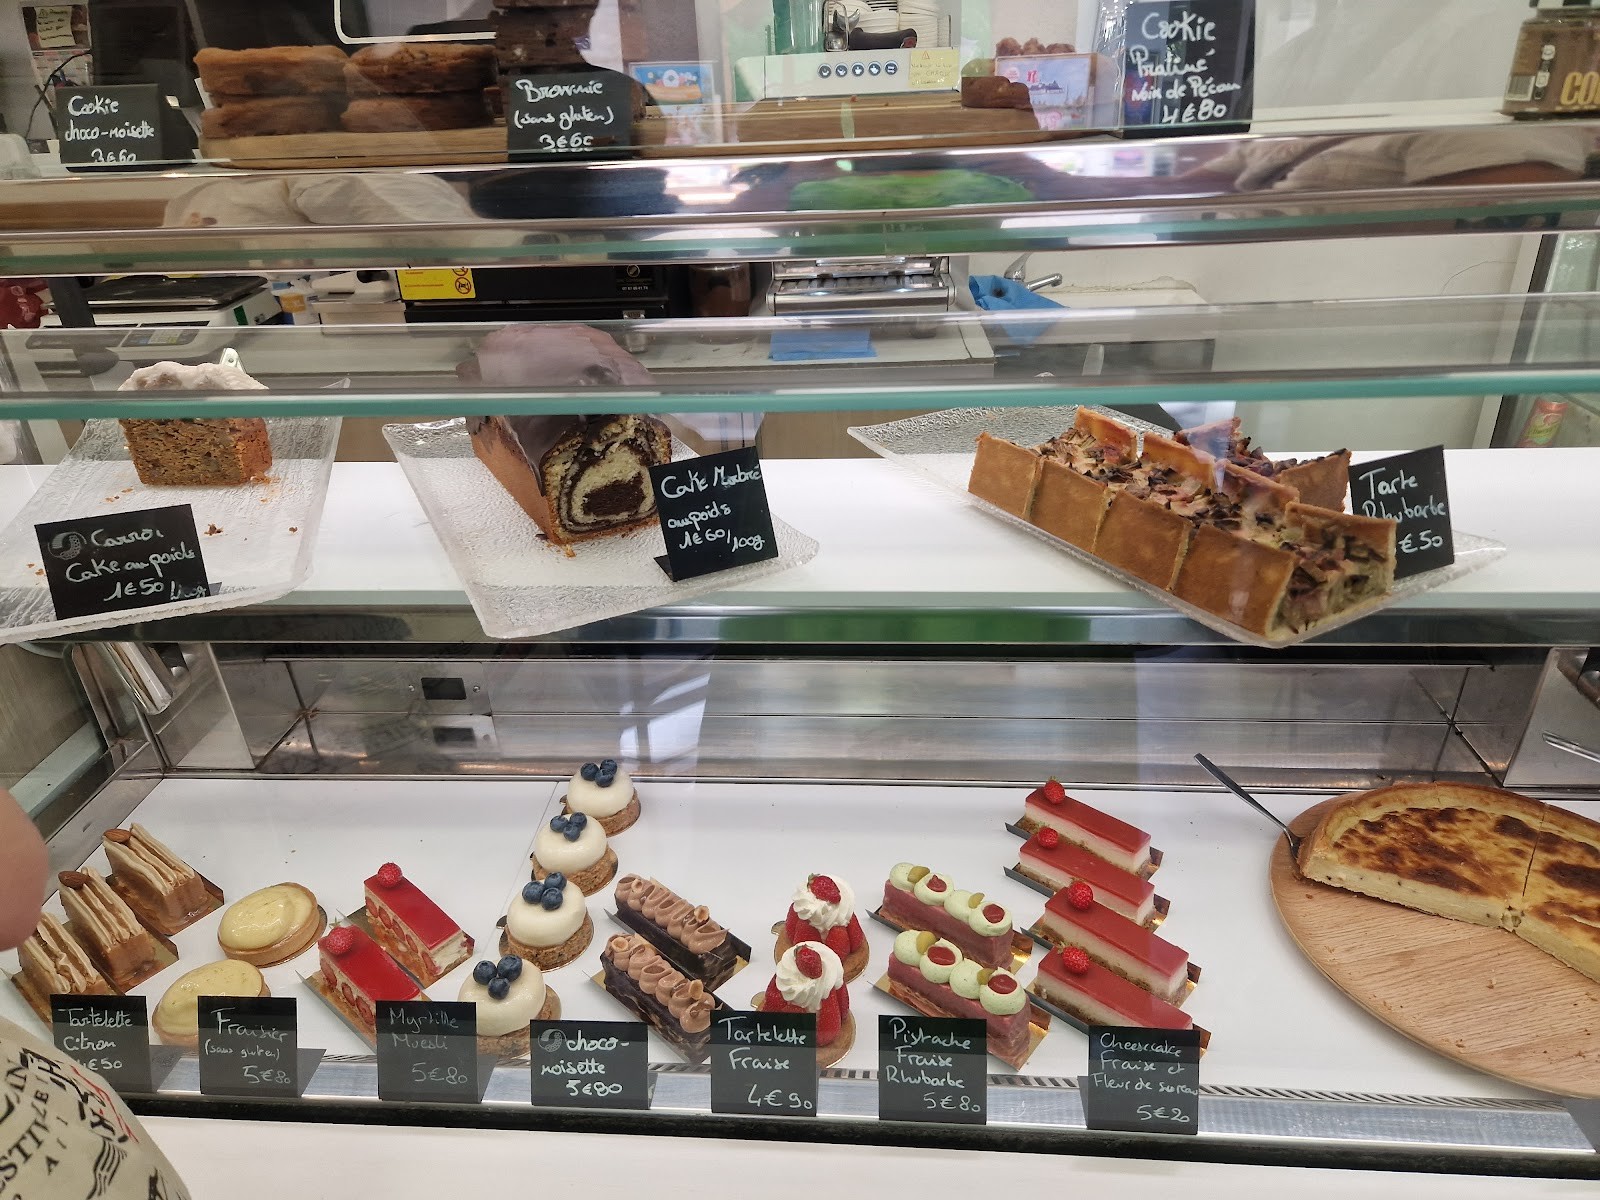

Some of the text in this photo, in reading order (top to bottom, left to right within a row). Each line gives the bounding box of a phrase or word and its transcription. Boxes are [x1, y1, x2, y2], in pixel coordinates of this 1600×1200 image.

[515, 78, 603, 103] Brownie
[1165, 78, 1188, 99] de
[1560, 71, 1600, 105] CO
[1161, 98, 1227, 124] 4€80
[1358, 466, 1419, 500] Tarte
[1397, 529, 1443, 554] €50
[57, 1007, 133, 1028] Tartelette
[389, 1007, 459, 1034] Myrtille
[63, 1031, 116, 1051] Citron
[391, 1032, 448, 1050] Muesli
[718, 1015, 807, 1045] Tartelette
[888, 1016, 971, 1050] Pistache
[894, 1045, 953, 1067] Fraise
[1100, 1032, 1182, 1057] Cheesecake
[540, 1057, 606, 1076] noisette
[728, 1046, 790, 1070] Fraise
[1100, 1049, 1185, 1075] Fraise et
[242, 1065, 291, 1084] 5€80
[412, 1062, 468, 1085] 5€80
[885, 1065, 965, 1089] Rhubarbe
[1091, 1071, 1131, 1090] Fleur
[1134, 1078, 1153, 1091] de
[565, 1079, 623, 1097] 5€80
[1136, 1104, 1190, 1123] 5€20
